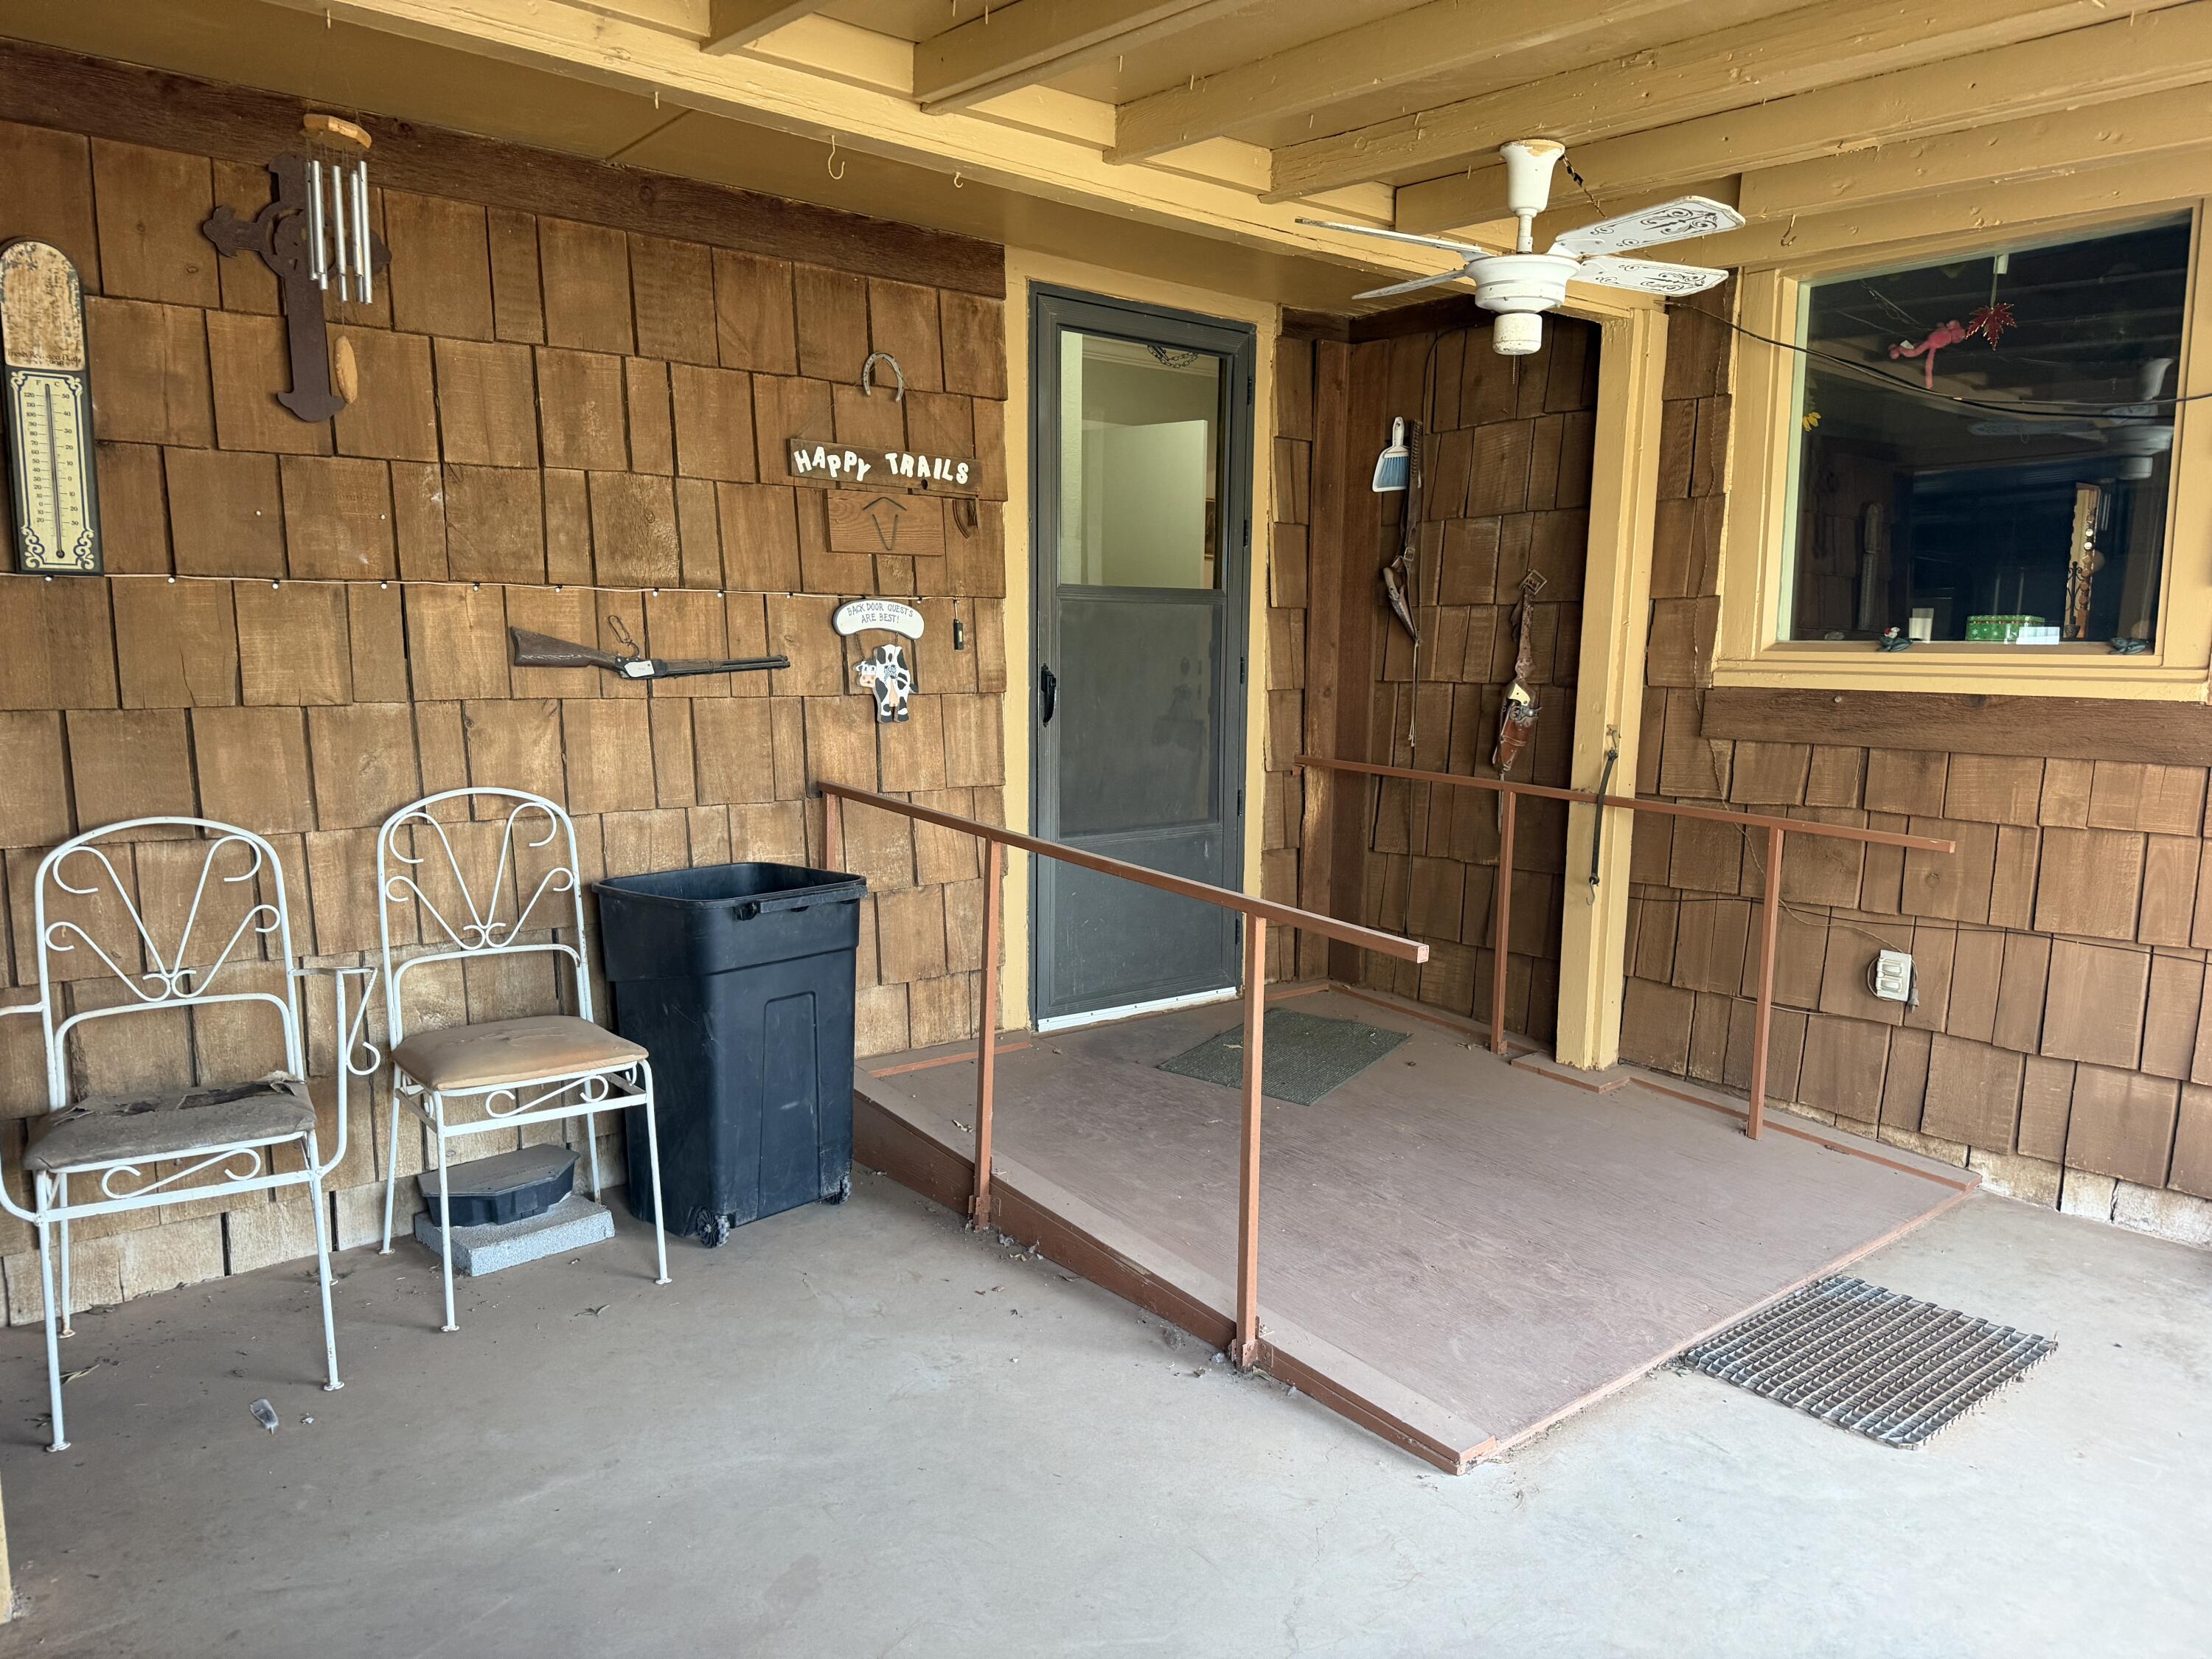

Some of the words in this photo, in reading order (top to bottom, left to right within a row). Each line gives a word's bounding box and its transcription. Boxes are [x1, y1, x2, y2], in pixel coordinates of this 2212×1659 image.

[793, 446, 872, 481] HAPPY
[885, 452, 969, 484] TRAILS
[846, 603, 865, 616] BACK
[866, 602, 884, 611] DOOR
[887, 604, 914, 617] GUESTS
[861, 613, 877, 624] ARE
[879, 613, 900, 624] BEST!
